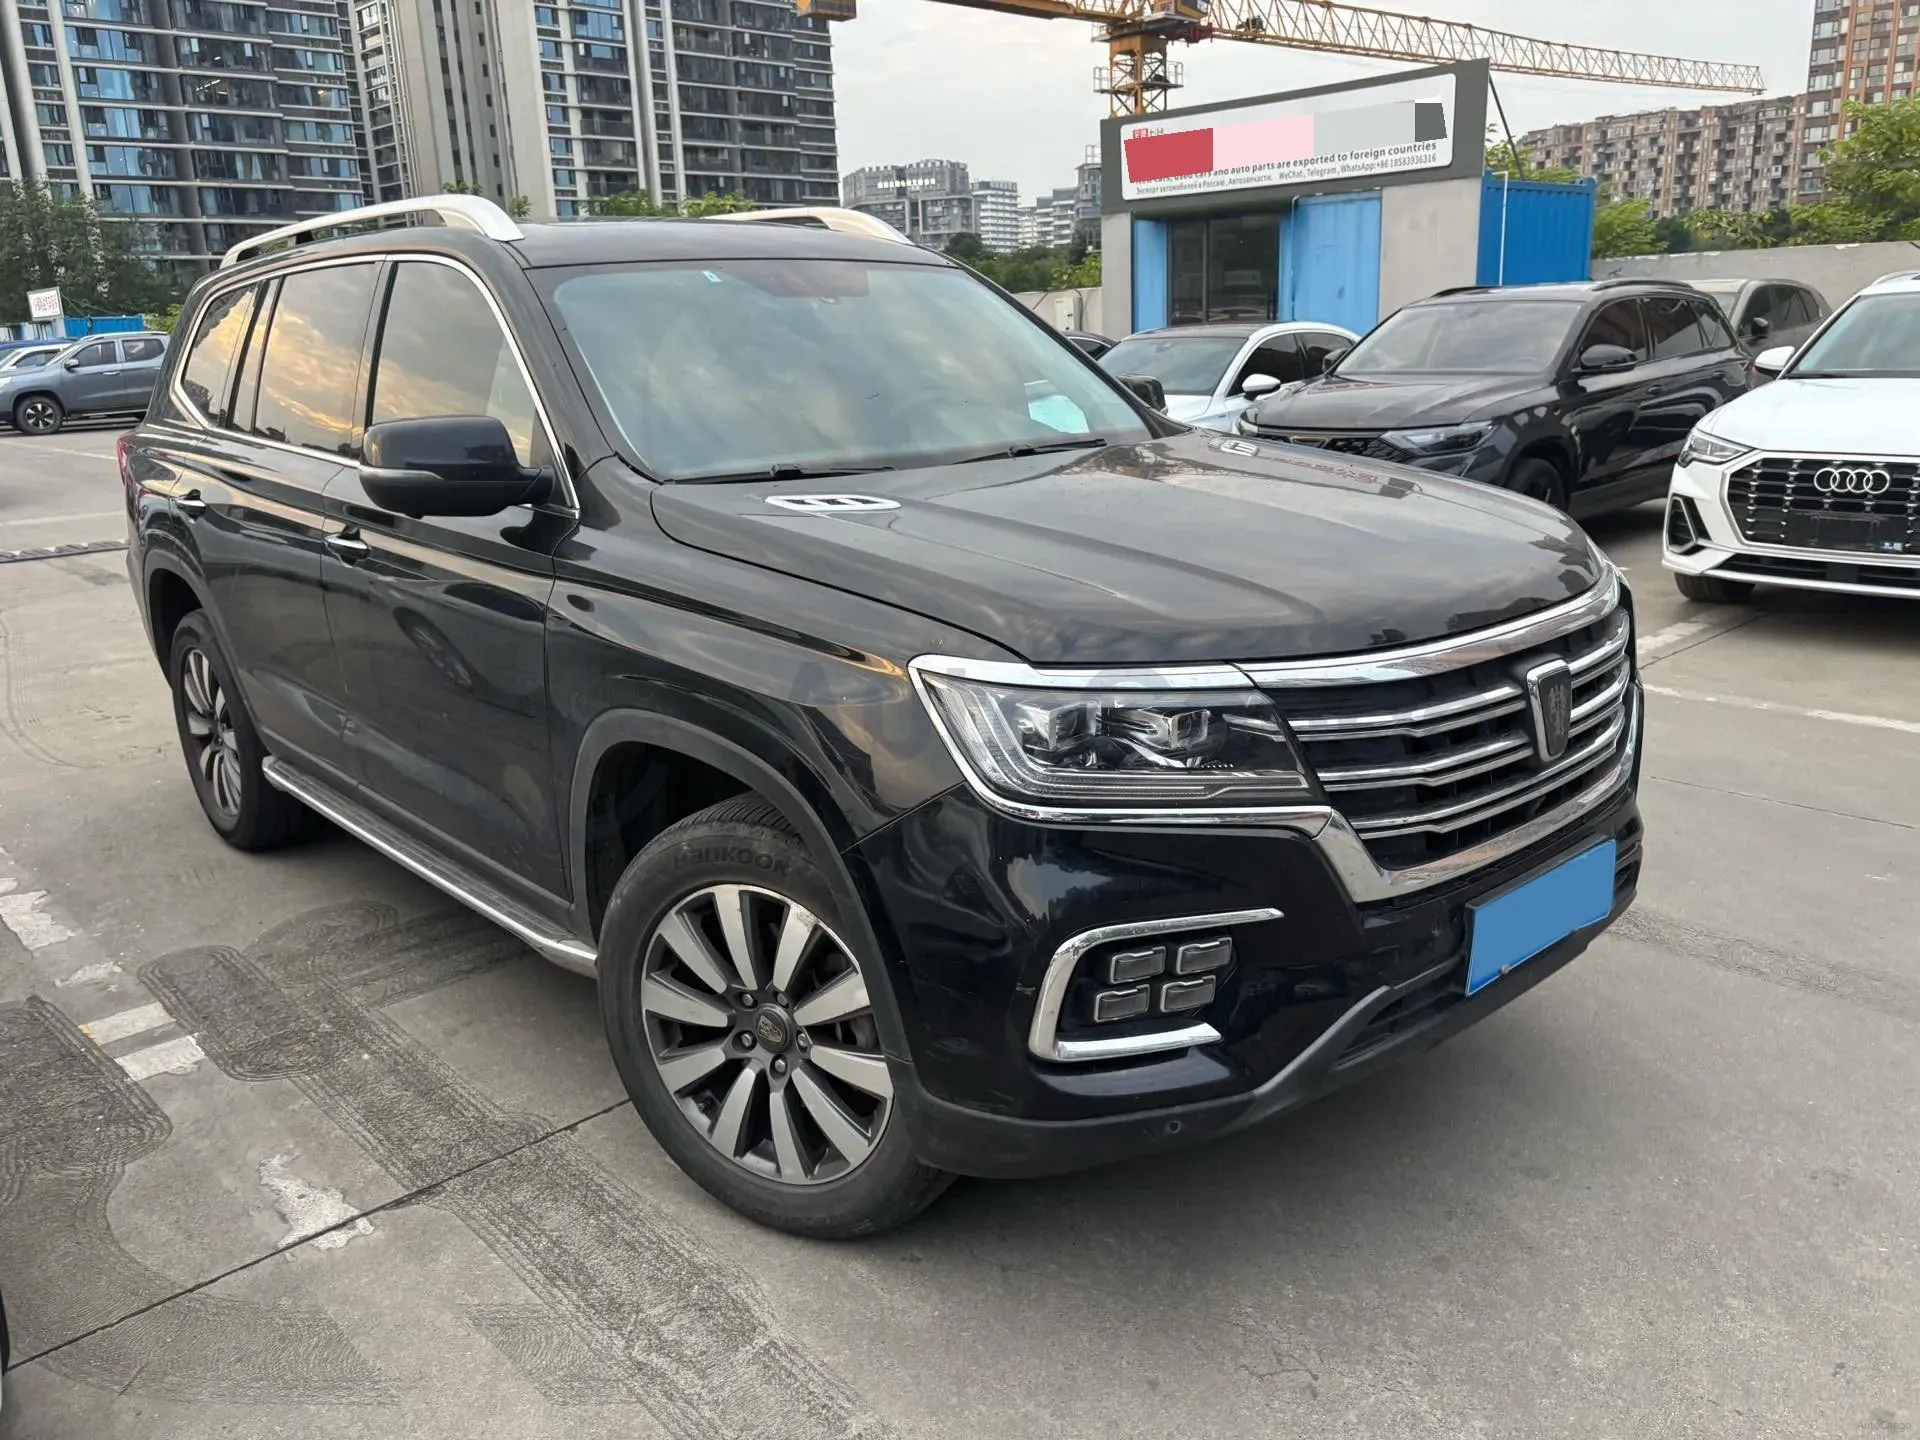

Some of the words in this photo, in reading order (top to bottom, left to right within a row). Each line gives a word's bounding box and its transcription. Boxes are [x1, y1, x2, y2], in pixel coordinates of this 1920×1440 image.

[1231, 164, 1250, 174] auto
[1252, 161, 1275, 174] parts
[1276, 160, 1291, 170] are
[1293, 153, 1335, 169] exported
[1338, 151, 1348, 162] to
[1350, 147, 1386, 161] foreign
[1388, 141, 1437, 155] countries
